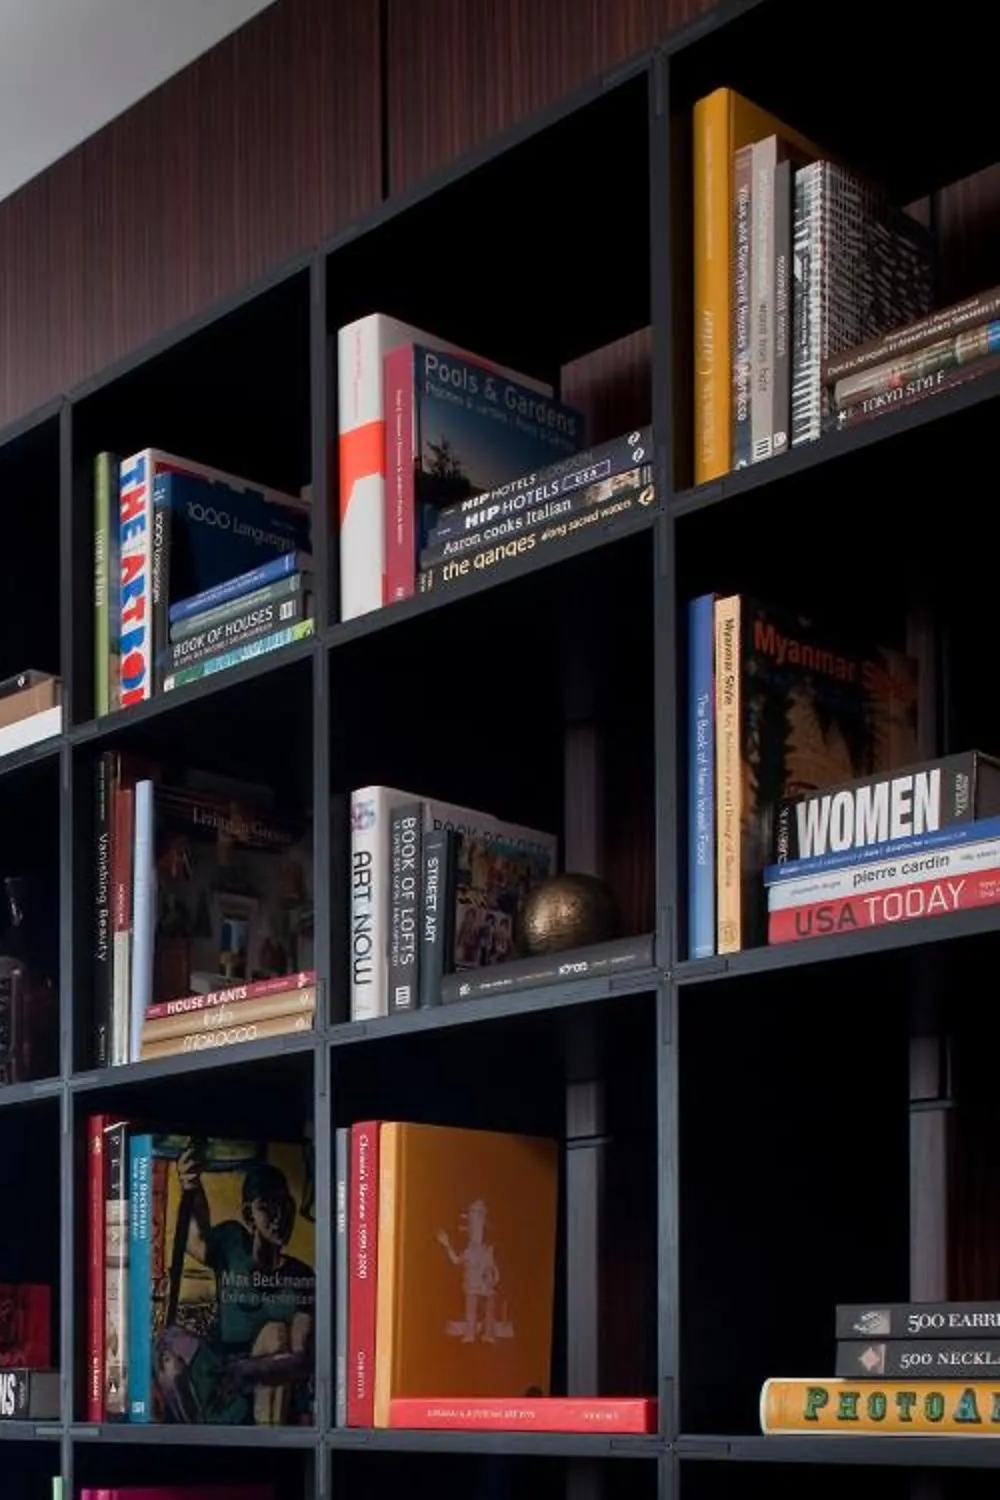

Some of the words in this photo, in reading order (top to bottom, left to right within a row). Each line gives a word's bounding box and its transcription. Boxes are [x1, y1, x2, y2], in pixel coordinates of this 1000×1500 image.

[424, 353, 479, 393] Pools
[484, 376, 498, 401] &
[503, 385, 577, 434] Gardens
[736, 365, 748, 420] Morocco
[862, 387, 903, 413] TOKYO
[907, 369, 945, 397] STYLE
[120, 456, 146, 543] THE
[187, 501, 232, 530] 1000
[461, 492, 490, 511] HIP
[490, 473, 537, 498] HOTELS
[464, 504, 500, 529] HIP
[501, 480, 559, 511] HOTELS
[442, 555, 469, 581] the
[473, 532, 536, 569] ganges
[541, 522, 567, 541] along
[443, 533, 481, 556] Aaron
[483, 517, 523, 541] cooks
[526, 498, 571, 525] Italian
[120, 552, 146, 624] ART
[172, 636, 206, 659] BOOK
[206, 628, 223, 648] OF
[225, 606, 274, 633] HOUSES
[753, 619, 857, 682] Myanmar
[723, 674, 736, 706] Style
[696, 718, 709, 749] Book
[796, 767, 942, 860] WOMEN
[400, 816, 416, 871] BOOK
[696, 835, 709, 866] Food
[353, 851, 372, 903] ART
[400, 875, 415, 902] OF
[425, 856, 439, 911] STREET
[852, 863, 897, 887] pierre
[900, 853, 950, 877] cardin
[98, 906, 109, 961] Beauty
[424, 911, 437, 943] ART
[793, 902, 858, 938] USA
[864, 880, 967, 925] TODAY
[353, 913, 372, 985] NOW
[400, 907, 415, 966] LOFTS
[167, 993, 204, 1015] HOUSE
[207, 985, 248, 1009] PLANTS
[220, 1270, 249, 1288] Max
[908, 1313, 945, 1334] 500
[948, 1312, 1000, 1329] EARRI
[899, 1352, 933, 1370] 500
